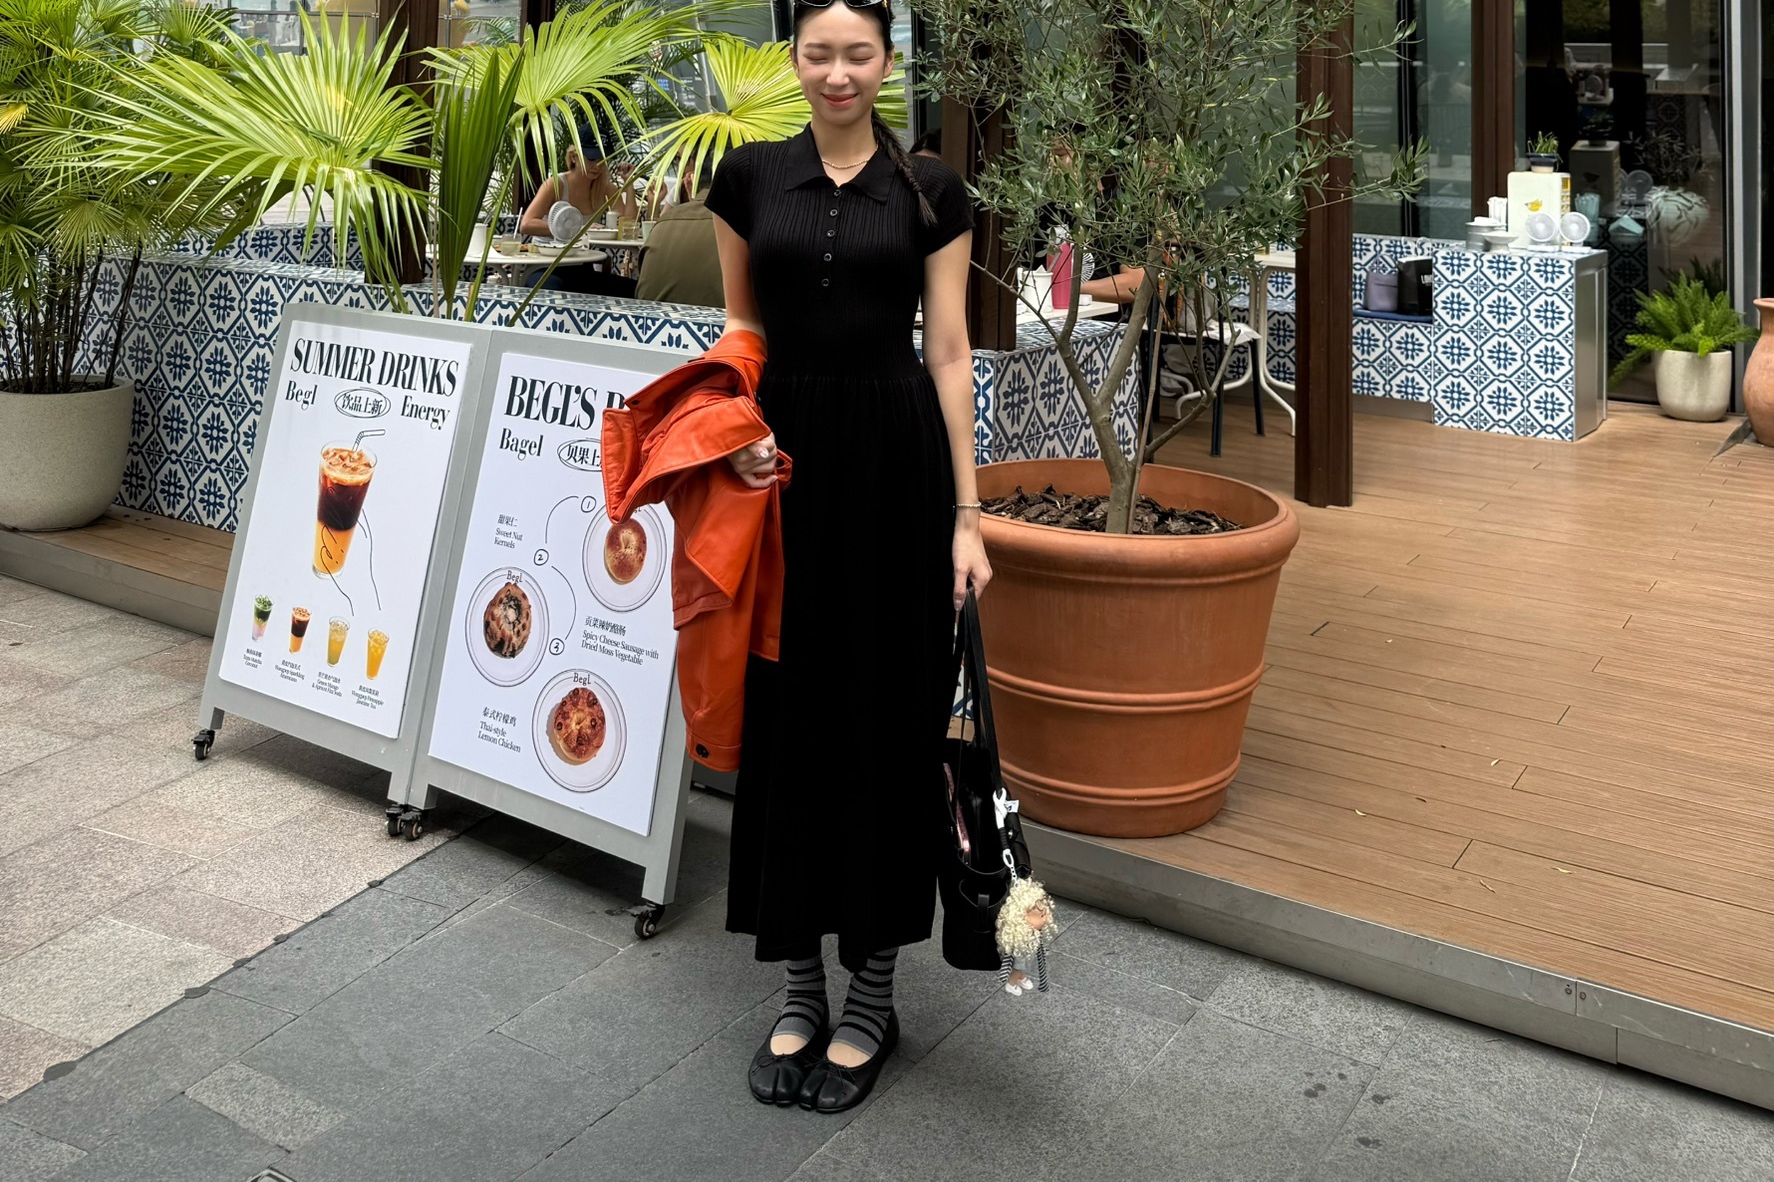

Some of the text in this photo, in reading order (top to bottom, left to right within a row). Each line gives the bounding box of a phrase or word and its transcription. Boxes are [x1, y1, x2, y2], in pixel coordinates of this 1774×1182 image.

[290, 338, 459, 397] SUMMER DRINKS
[285, 380, 318, 410] Begl
[342, 392, 384, 415] 饮品上新
[504, 375, 598, 430] BEGL'S
[401, 395, 450, 430] Energy
[499, 428, 544, 460] Bagel
[566, 443, 602, 467] 贝果上
[581, 639, 644, 665] Dried Moss Vegetable
[583, 629, 659, 660] Spicy Cheese Sausage with
[478, 730, 521, 753] Lemon Chicken
